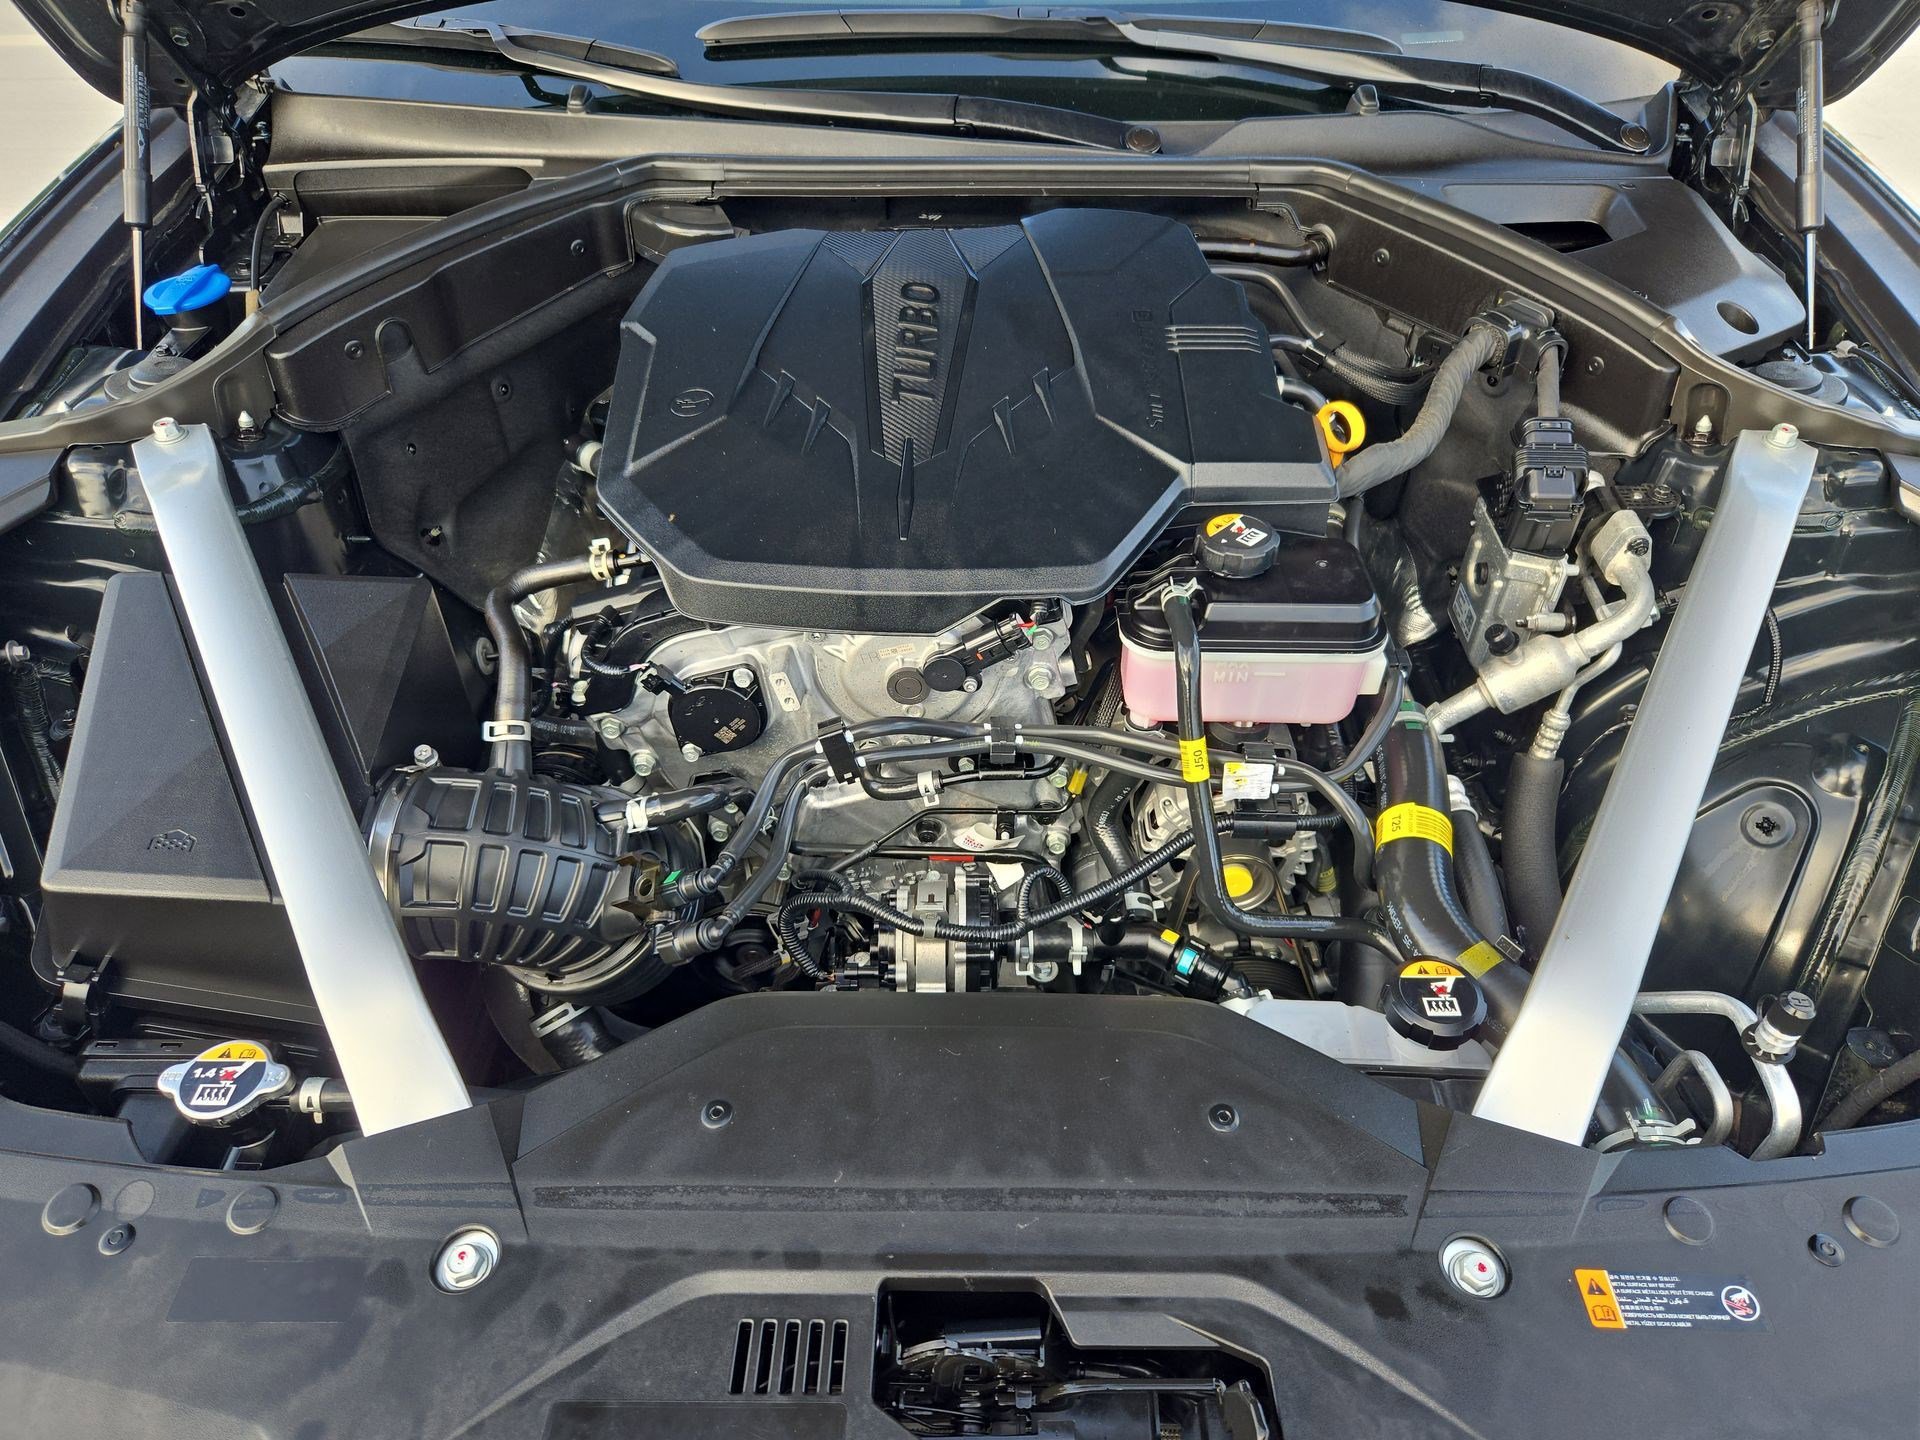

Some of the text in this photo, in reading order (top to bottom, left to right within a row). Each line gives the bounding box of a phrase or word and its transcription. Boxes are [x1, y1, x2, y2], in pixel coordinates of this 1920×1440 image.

[891, 282, 940, 405] TURBO
[1212, 671, 1249, 684] MIN
[1193, 749, 1205, 770] J50
[1391, 813, 1402, 833] T25
[192, 1067, 217, 1079] 1.4
